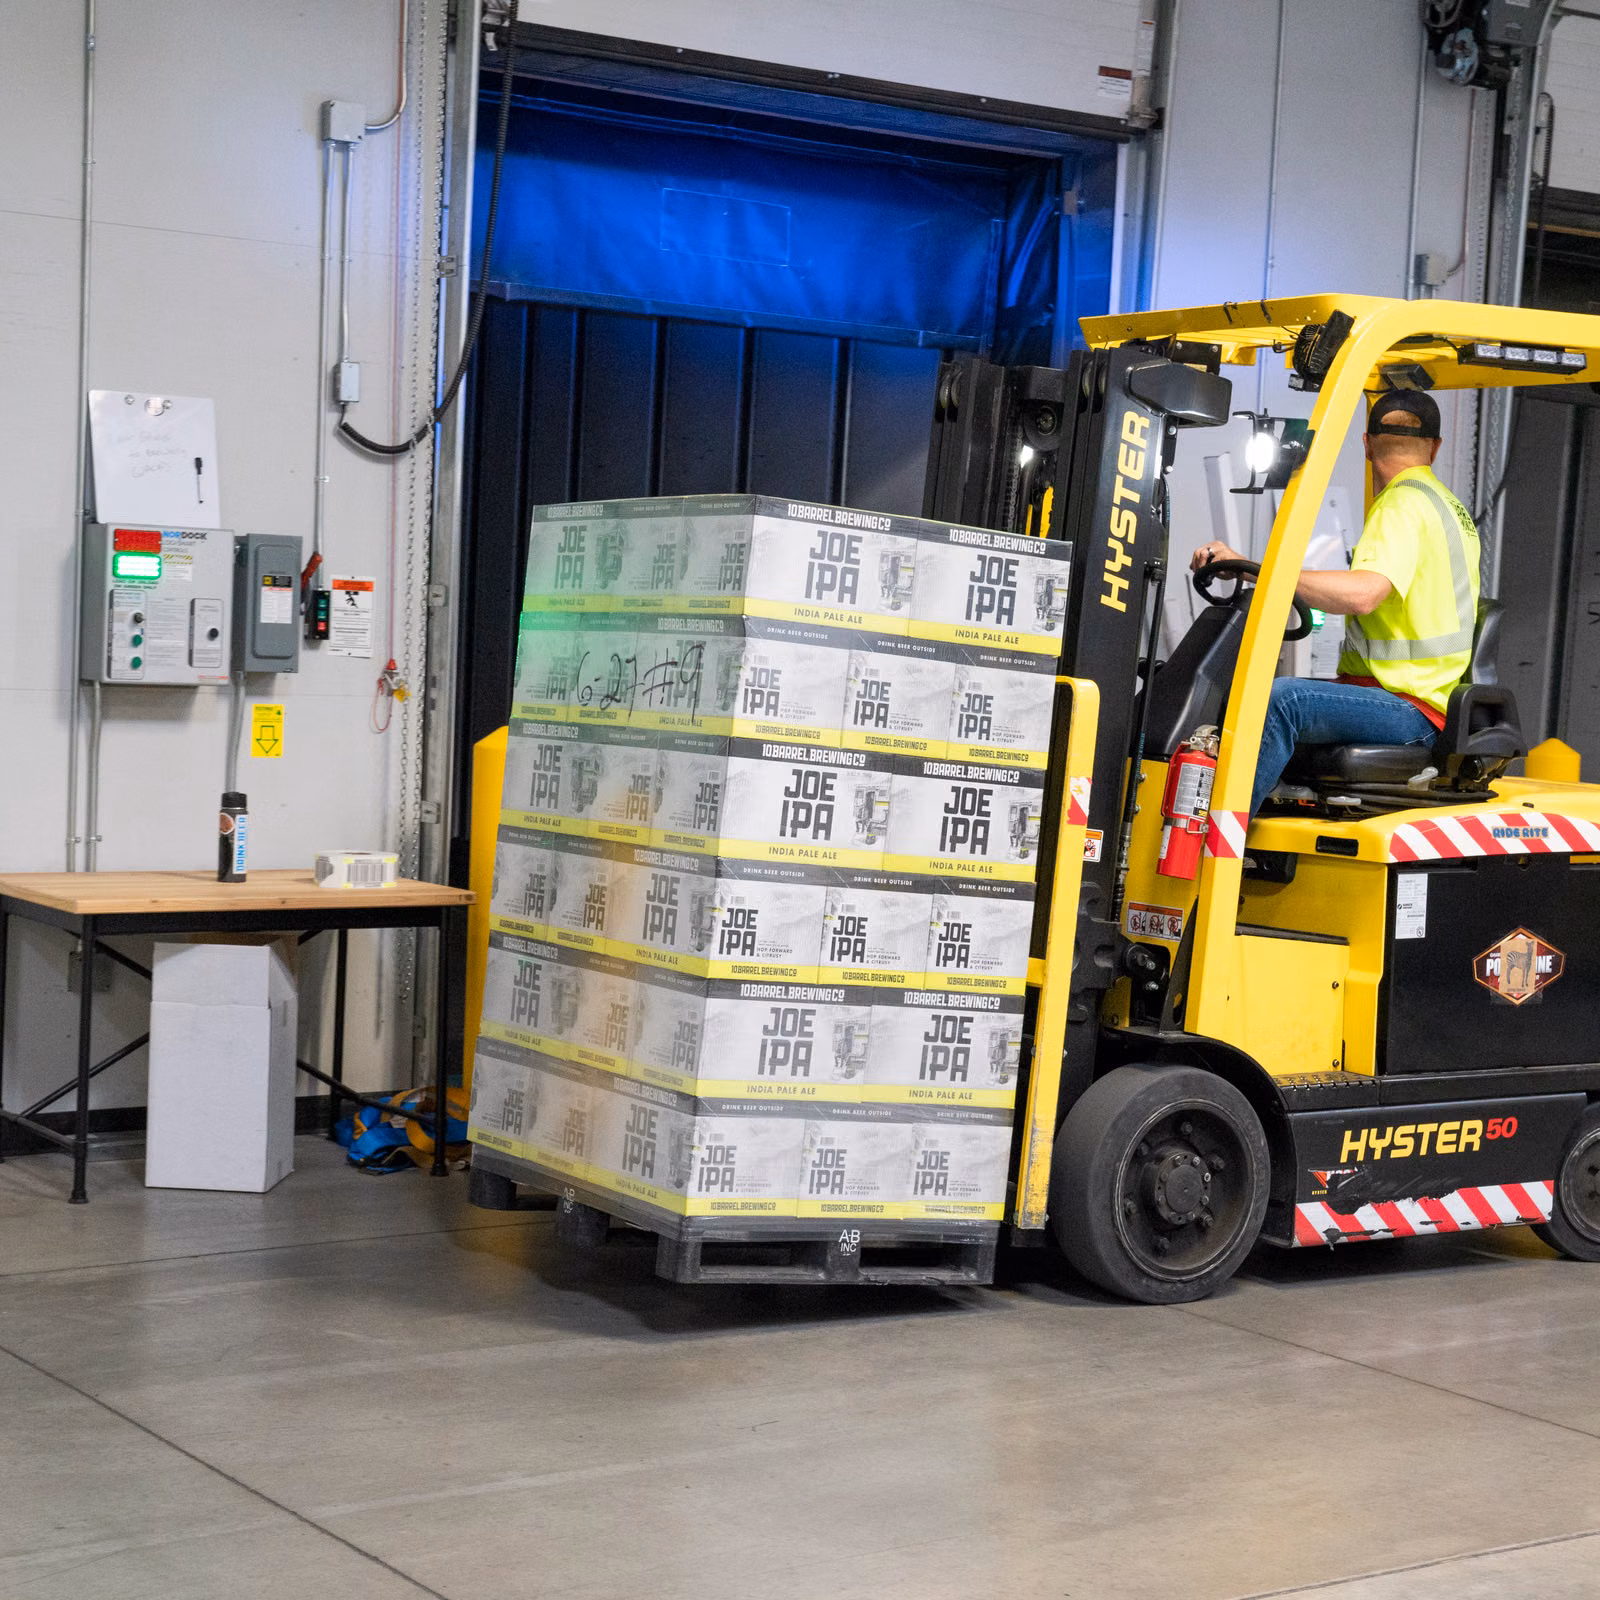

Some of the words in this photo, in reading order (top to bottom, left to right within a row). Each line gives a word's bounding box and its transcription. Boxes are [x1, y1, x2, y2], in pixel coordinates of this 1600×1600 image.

[1100, 410, 1150, 613] HYSTER
[557, 525, 587, 553] JOE
[808, 529, 863, 565] JOE
[553, 554, 584, 588] IPA
[804, 561, 859, 604] IPA
[968, 553, 1019, 588] JOE
[793, 607, 820, 619] INDIA
[823, 611, 844, 622] PALE
[847, 614, 862, 624] ALE
[964, 584, 1016, 626] IPA
[954, 628, 980, 640] INDIA
[982, 632, 1002, 643] PALE
[1004, 635, 1019, 645] ALE
[745, 666, 781, 690] JOE
[856, 678, 891, 702] JOE
[741, 688, 779, 716] IPA
[853, 700, 889, 728] IPA
[959, 692, 994, 715] JOE
[956, 713, 992, 740] IPA
[532, 743, 563, 773] JOE
[529, 771, 560, 809] IPA
[695, 782, 720, 804] JOE
[783, 768, 837, 802] JOE
[942, 785, 993, 818] JOE
[692, 803, 718, 831] IPA
[778, 800, 834, 840] IPA
[938, 816, 990, 855] IPA
[1492, 826, 1520, 838] RIDE
[1522, 826, 1548, 838] RITE
[768, 846, 794, 856] INDIA
[797, 848, 818, 858] PALE
[822, 850, 837, 860] ALE
[929, 860, 953, 870] INDIA
[956, 862, 976, 872] PALE
[978, 864, 993, 873] ALE
[645, 873, 680, 906] JOE
[642, 903, 677, 945] IPA
[721, 907, 758, 930] JOE
[832, 915, 868, 937] JOE
[938, 921, 972, 943] JOE
[718, 929, 756, 956] IPA
[829, 936, 866, 963] IPA
[935, 942, 970, 968] IPA
[512, 959, 543, 992] JOE
[509, 987, 540, 1028] IPA
[762, 1006, 816, 1038] JOE
[922, 1014, 974, 1044] JOE
[757, 1038, 813, 1076] IPA
[918, 1044, 971, 1081] IPA
[746, 1084, 773, 1094] INDIA
[776, 1085, 797, 1095] PALE
[800, 1086, 816, 1095] ALE
[908, 1089, 933, 1098] INDIA
[936, 1090, 956, 1099] PALE
[958, 1091, 973, 1100] ALE
[625, 1103, 659, 1140] JOE
[1340, 1120, 1484, 1163] HYSTER
[1486, 1116, 1518, 1140] 50
[621, 1133, 656, 1179] IPA
[700, 1145, 737, 1166] JOE
[811, 1148, 847, 1168] JOE
[915, 1150, 950, 1170] JOE
[697, 1166, 735, 1192] IPA
[808, 1169, 845, 1194] IPA
[912, 1171, 948, 1196] IPA
[840, 1242, 857, 1252] INC
